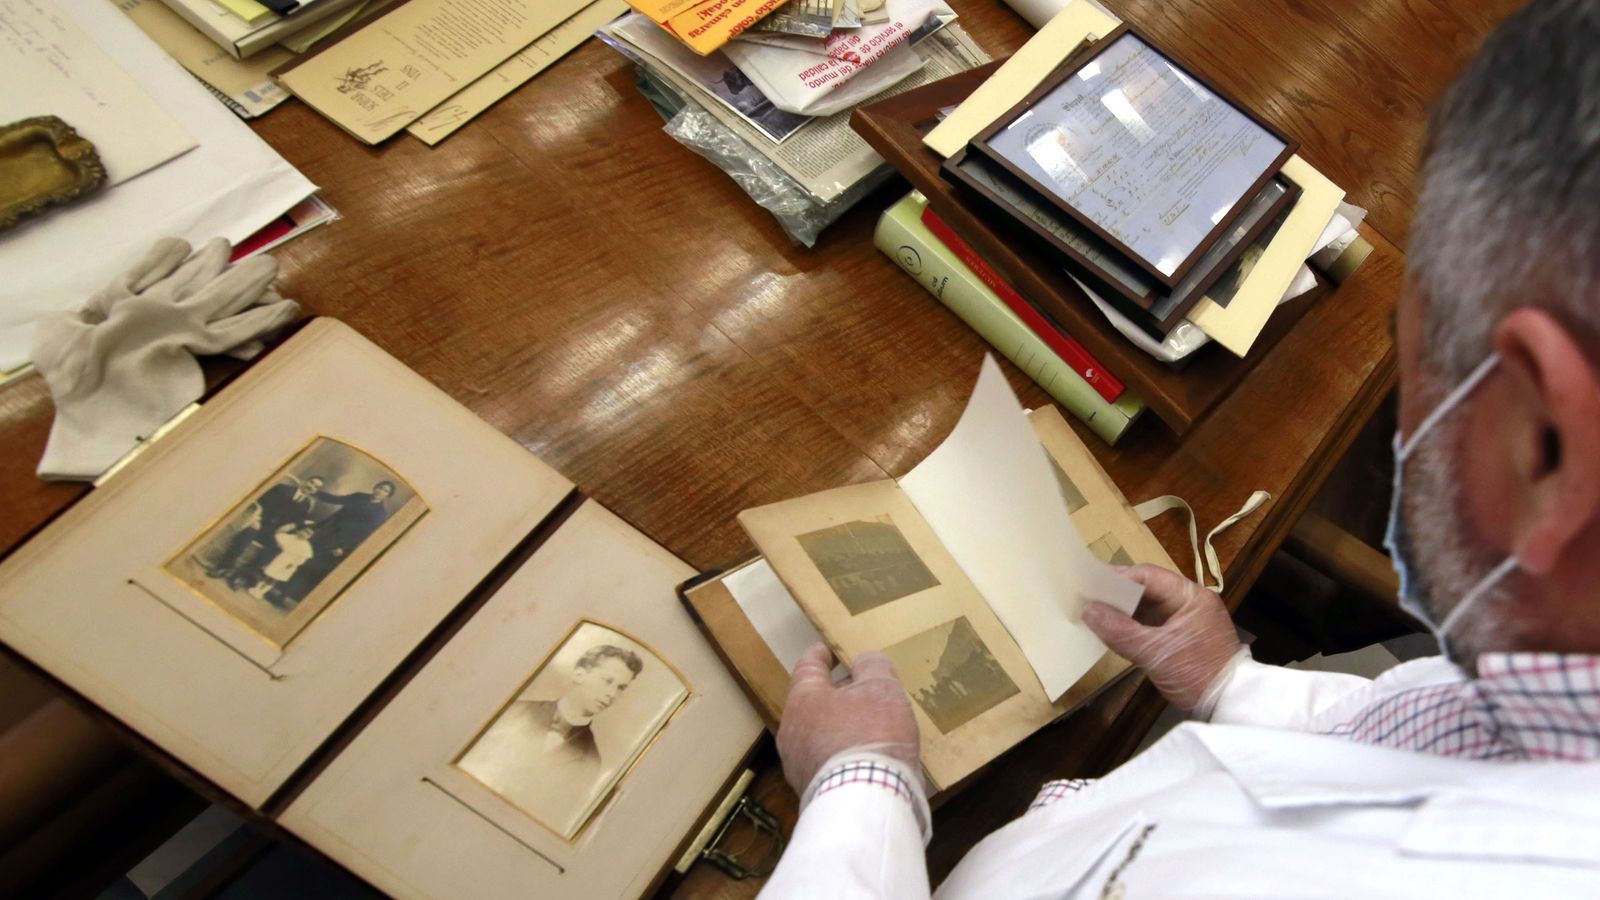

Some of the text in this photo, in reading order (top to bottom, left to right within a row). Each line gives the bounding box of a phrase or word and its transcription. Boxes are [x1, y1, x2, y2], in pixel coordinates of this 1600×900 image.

[696, 0, 728, 21] odak!
[687, 8, 733, 38] cámaras
[894, 21, 904, 30] el
[848, 34, 861, 48] del
[870, 26, 897, 47] servicio
[859, 43, 872, 55] de
[828, 58, 839, 67] la
[798, 63, 829, 81] calidad
[838, 63, 852, 77] del
